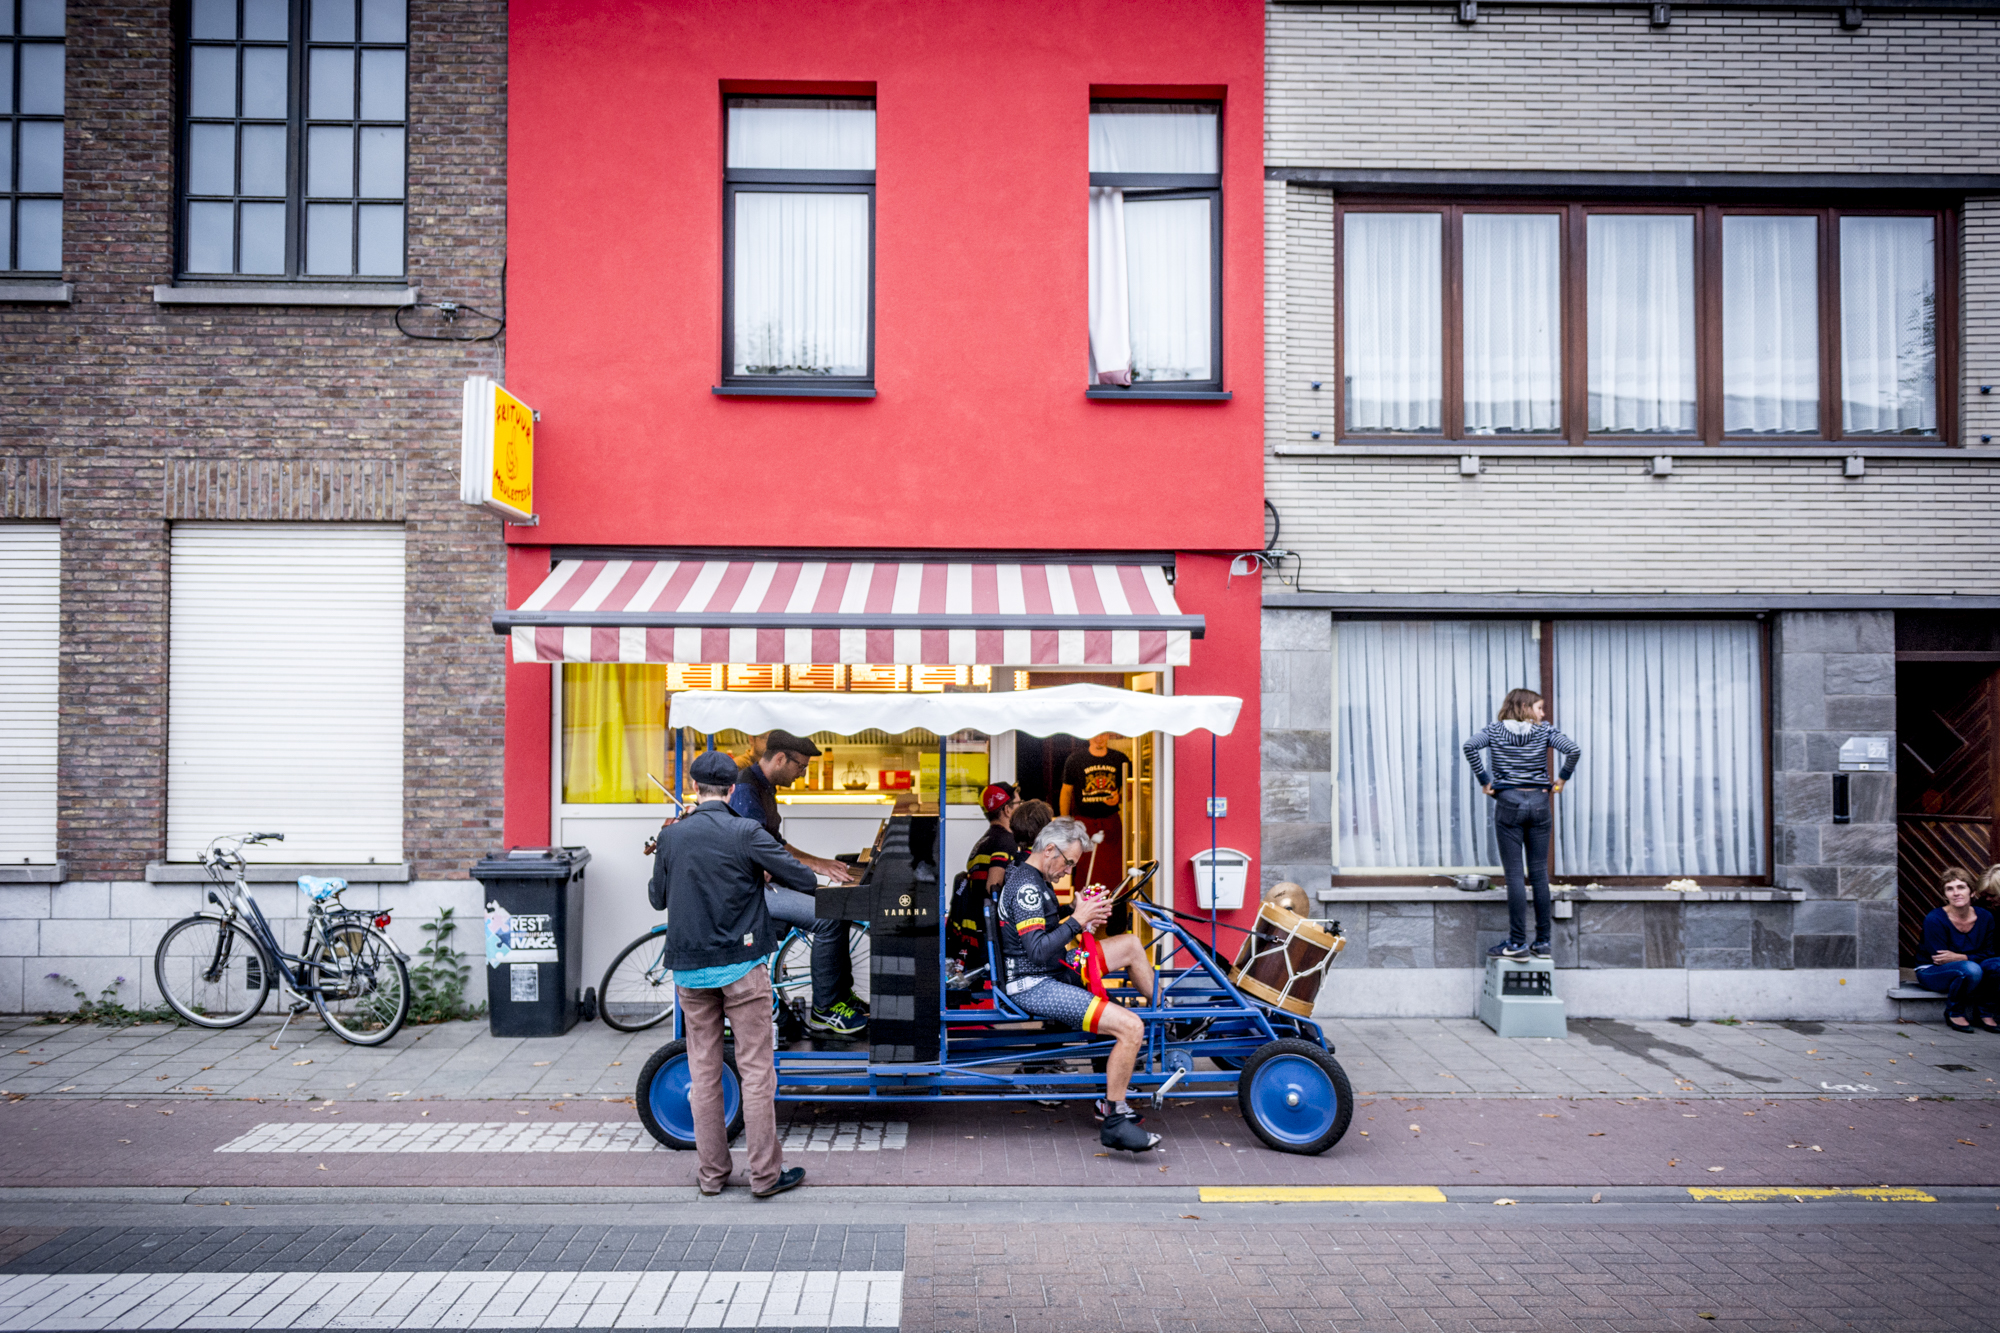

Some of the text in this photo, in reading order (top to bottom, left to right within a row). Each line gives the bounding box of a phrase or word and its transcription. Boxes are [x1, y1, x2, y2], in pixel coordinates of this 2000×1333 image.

[496, 403, 531, 445] FRITUUR
[1084, 764, 1116, 774] HOLLAND
[884, 907, 928, 917] YAMAHA
[510, 917, 545, 932] REST
